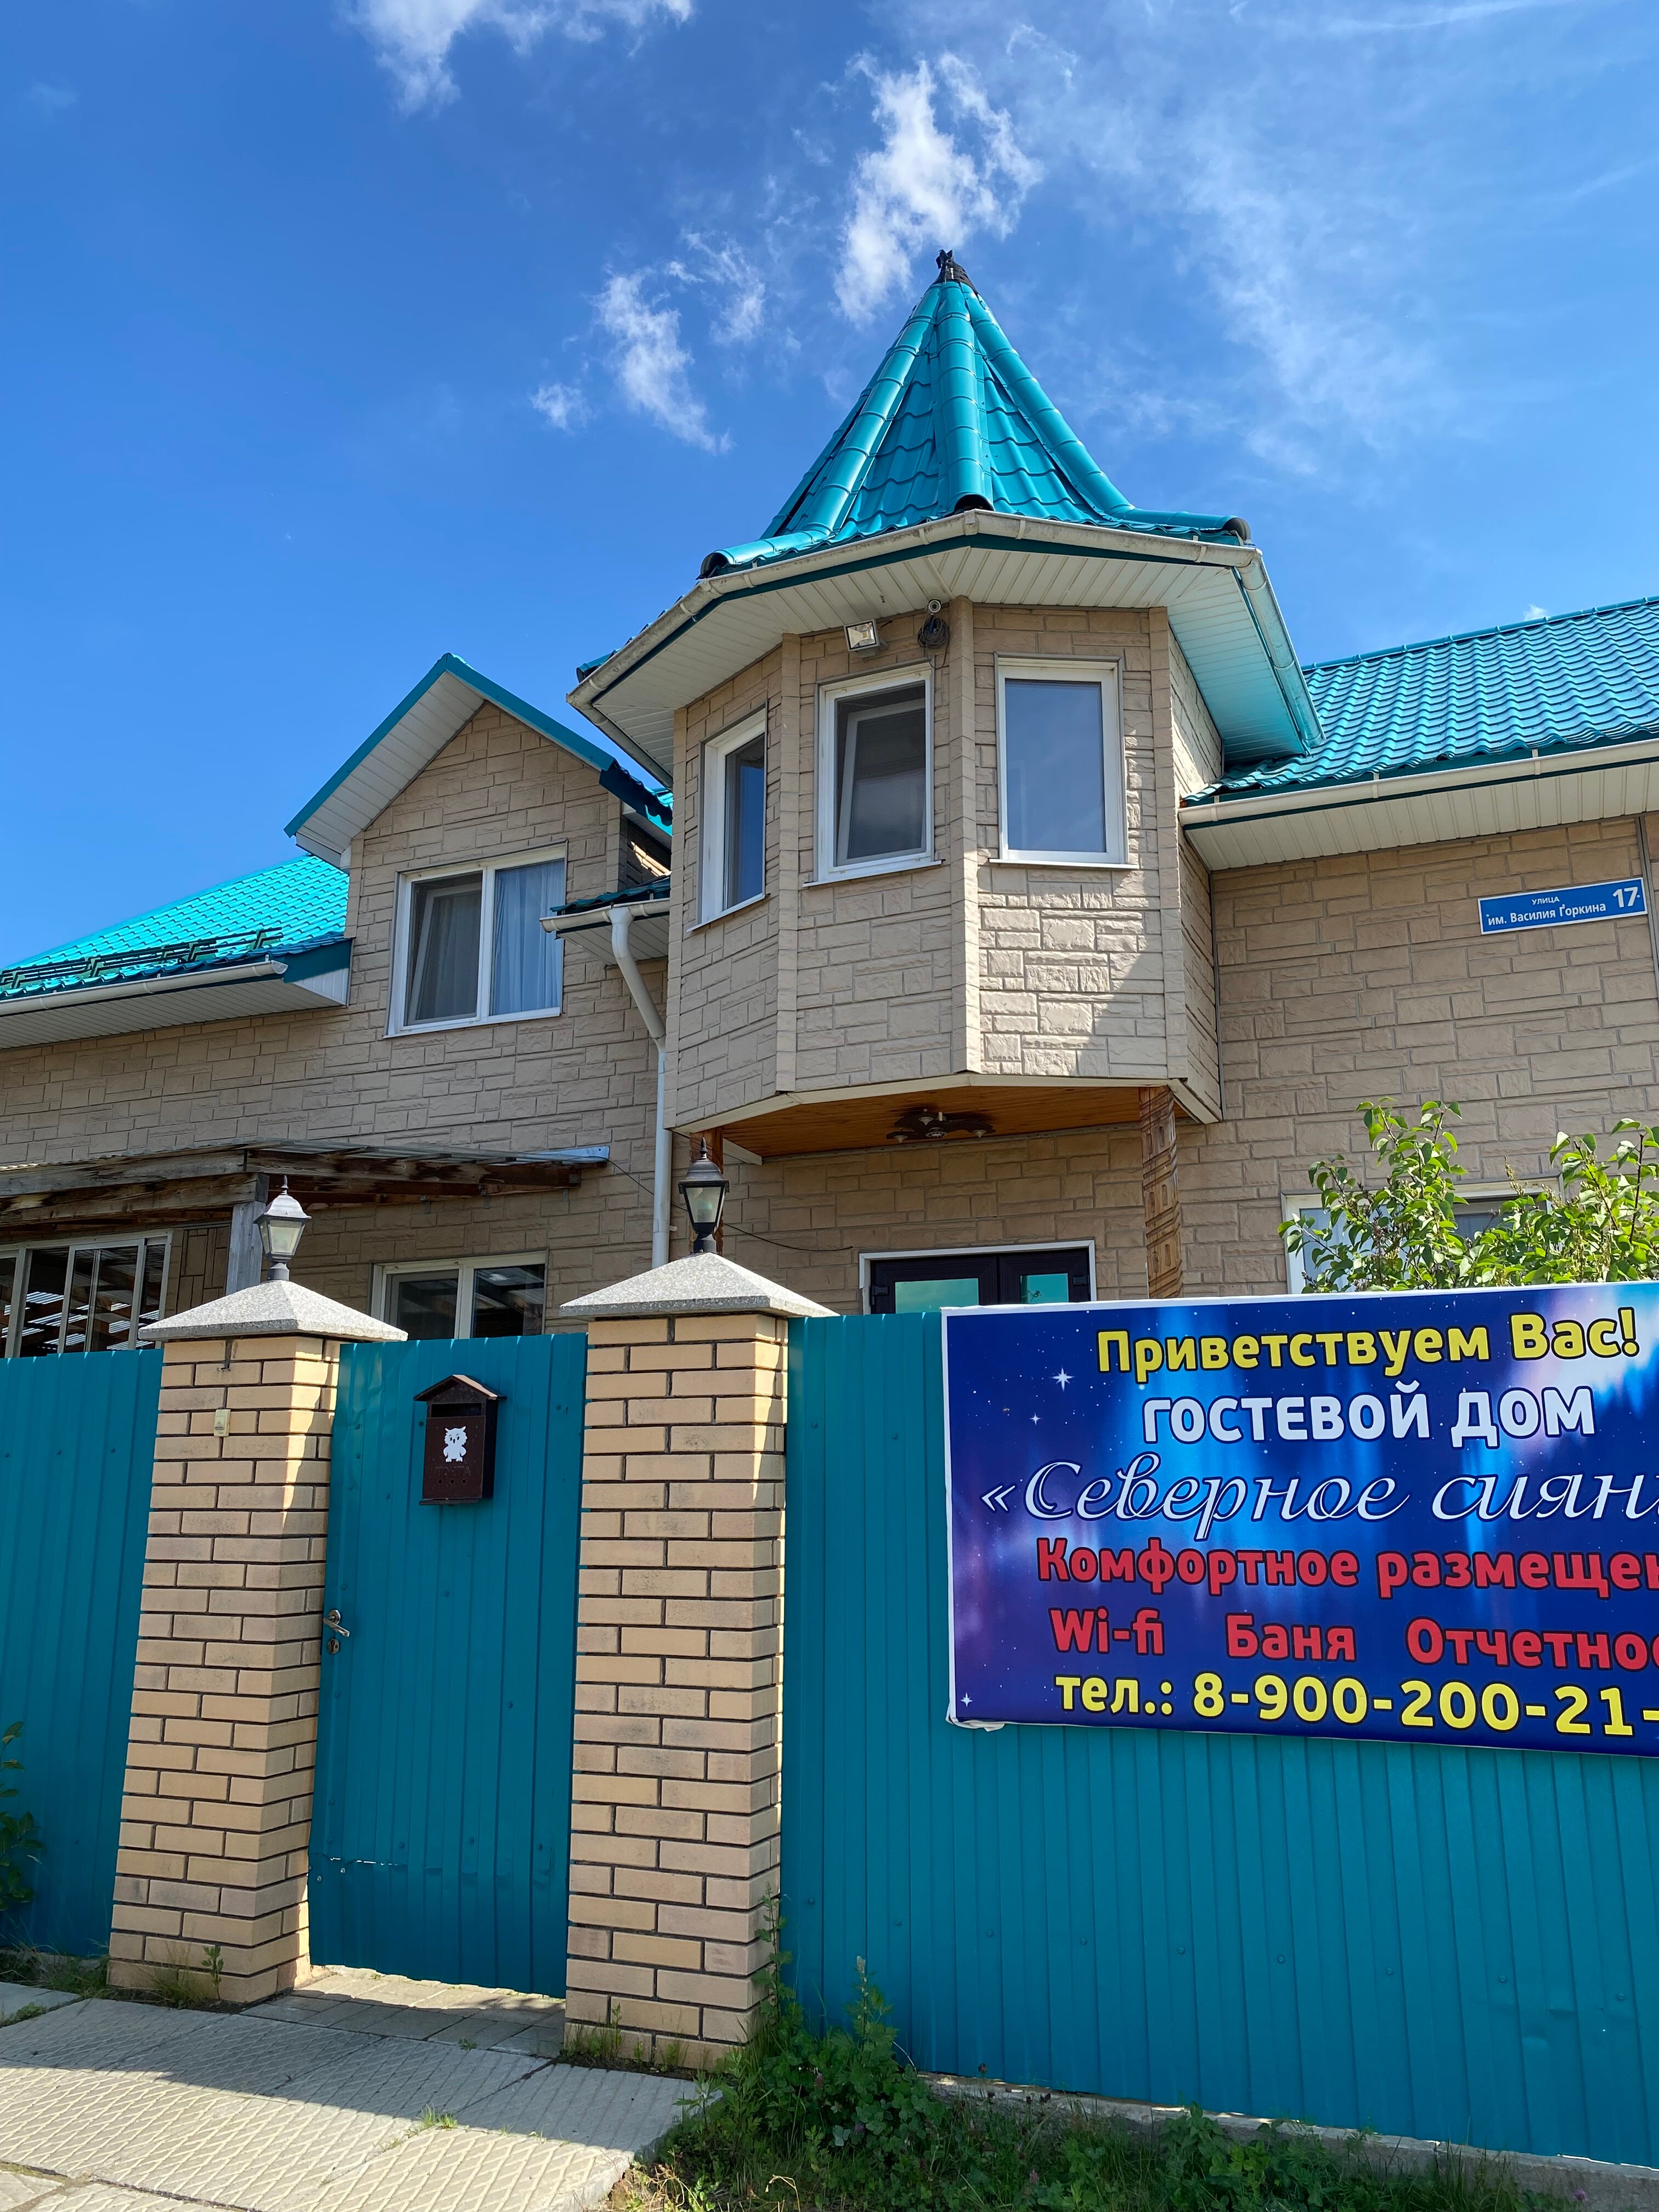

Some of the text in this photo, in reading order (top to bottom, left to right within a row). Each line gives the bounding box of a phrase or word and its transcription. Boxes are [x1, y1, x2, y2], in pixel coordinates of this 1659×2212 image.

[1487, 902, 1606, 926] им. Василия Горкина
[1532, 896, 1560, 906] УЛИЦА
[1612, 886, 1639, 908] 17
[1097, 1310, 1638, 1383] Приветствуем Вас!
[1143, 1379, 1596, 1448] ГОСТЕВОЙ ДОМ
[981, 1453, 1659, 1540] «Северное сиян
[1037, 1538, 1359, 1595] Комфортное
[1049, 1607, 1659, 1671] Wi-fi Баня Отчетно
[1056, 1673, 1659, 1736] тел.: 8-900-200-21-
